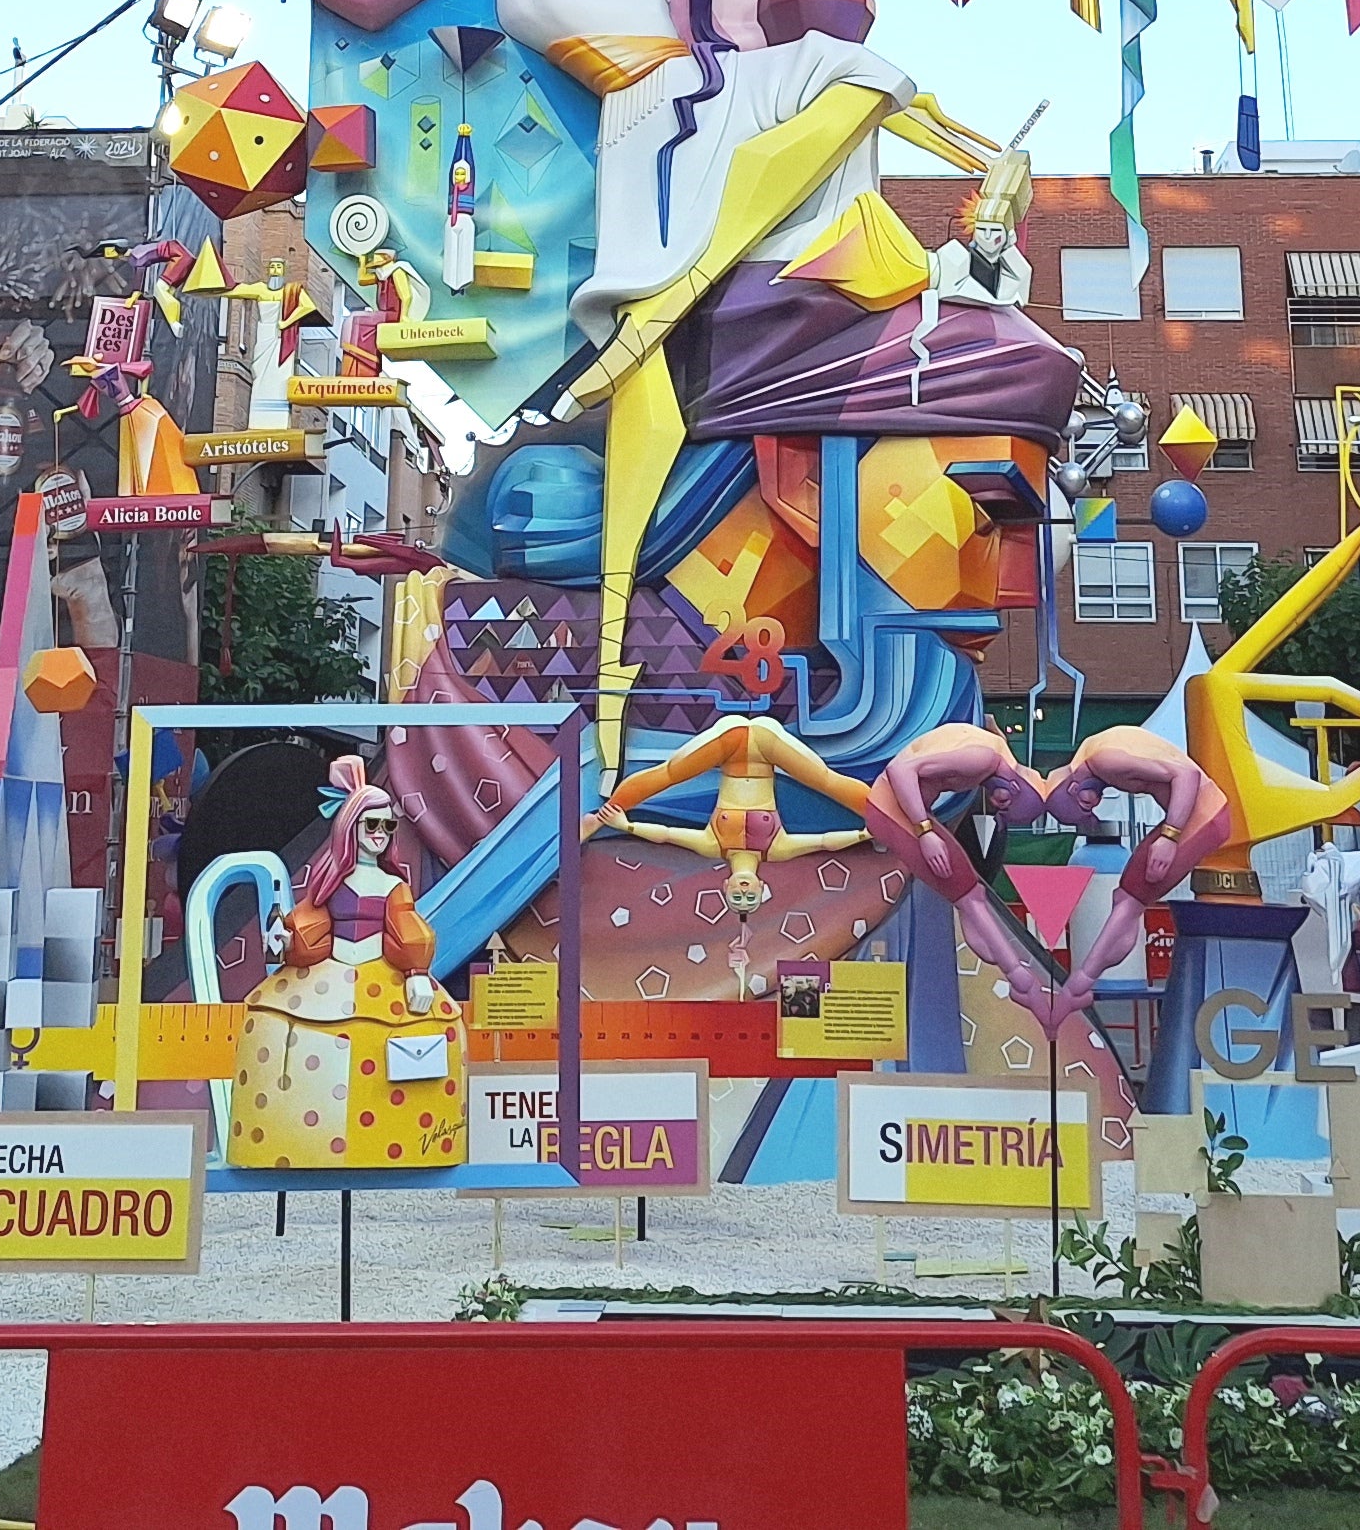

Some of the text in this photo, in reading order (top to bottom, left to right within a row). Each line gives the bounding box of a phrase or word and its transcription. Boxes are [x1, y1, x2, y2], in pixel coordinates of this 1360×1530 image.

[1010, 103, 1046, 149] PITAGORAS
[9, 149, 32, 158] JOAN
[11, 138, 22, 147] LA
[105, 139, 140, 159] 2024
[100, 308, 134, 327] Des
[101, 326, 133, 340] car
[399, 326, 464, 341] Uhlenbeck
[96, 335, 122, 352] tes
[293, 379, 393, 399] Arquímedes
[199, 437, 289, 458] Aristóteles
[99, 505, 202, 525] Alicia Boole
[484, 1090, 559, 1120] TENE
[509, 1127, 534, 1149] LA
[879, 1117, 1064, 1168] SIMETRÍA
